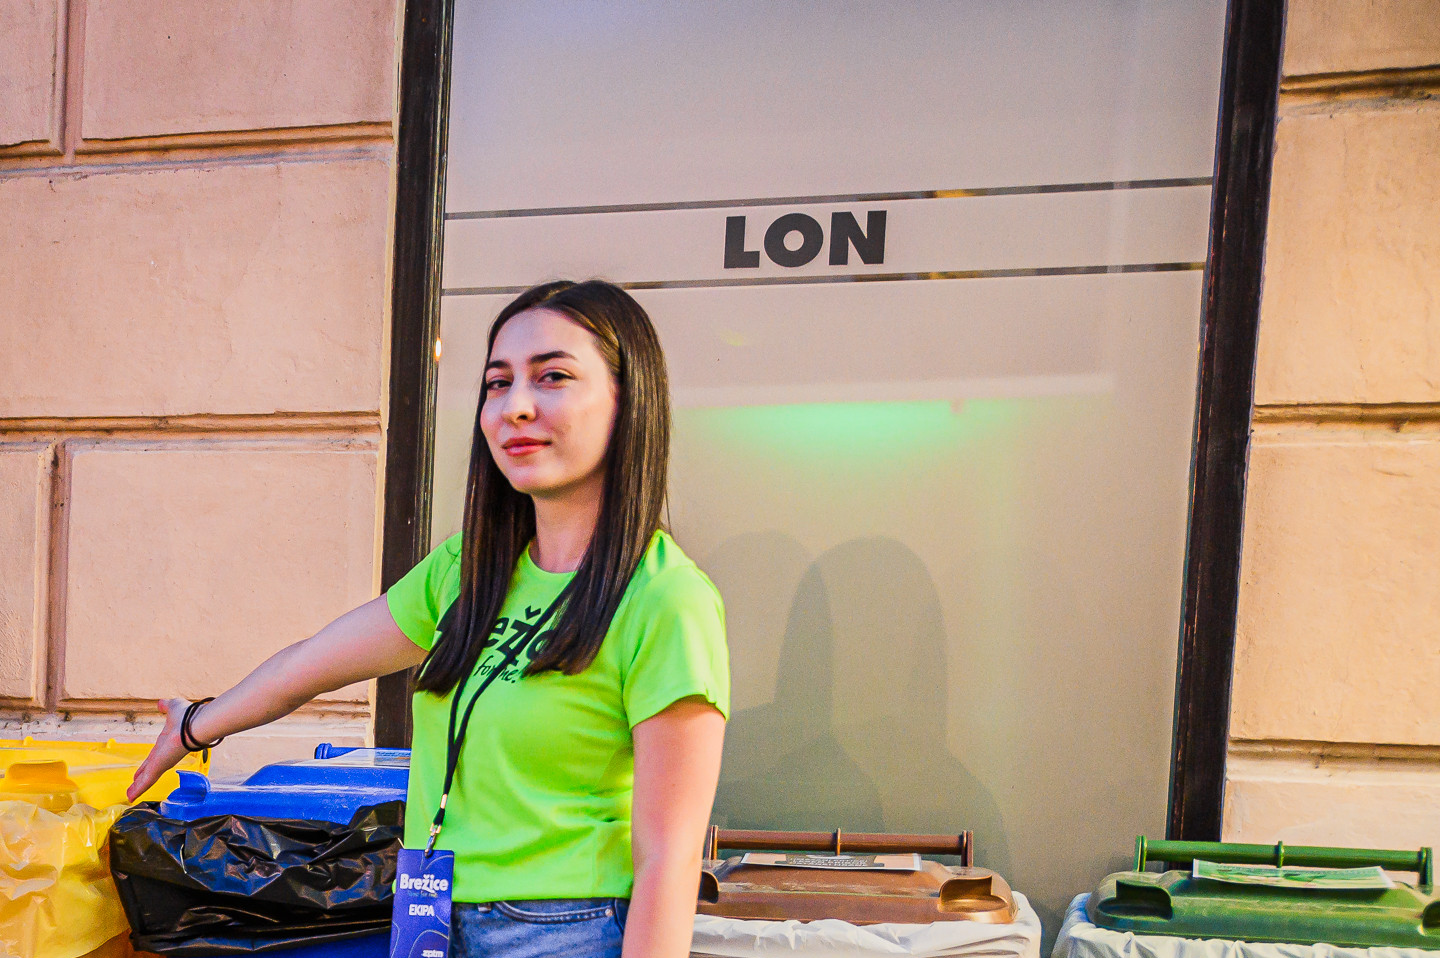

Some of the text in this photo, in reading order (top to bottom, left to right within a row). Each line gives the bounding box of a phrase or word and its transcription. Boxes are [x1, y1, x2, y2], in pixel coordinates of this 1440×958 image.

[723, 210, 888, 269] LON
[400, 873, 449, 894] Brežice
[408, 904, 435, 916] EKIPA
